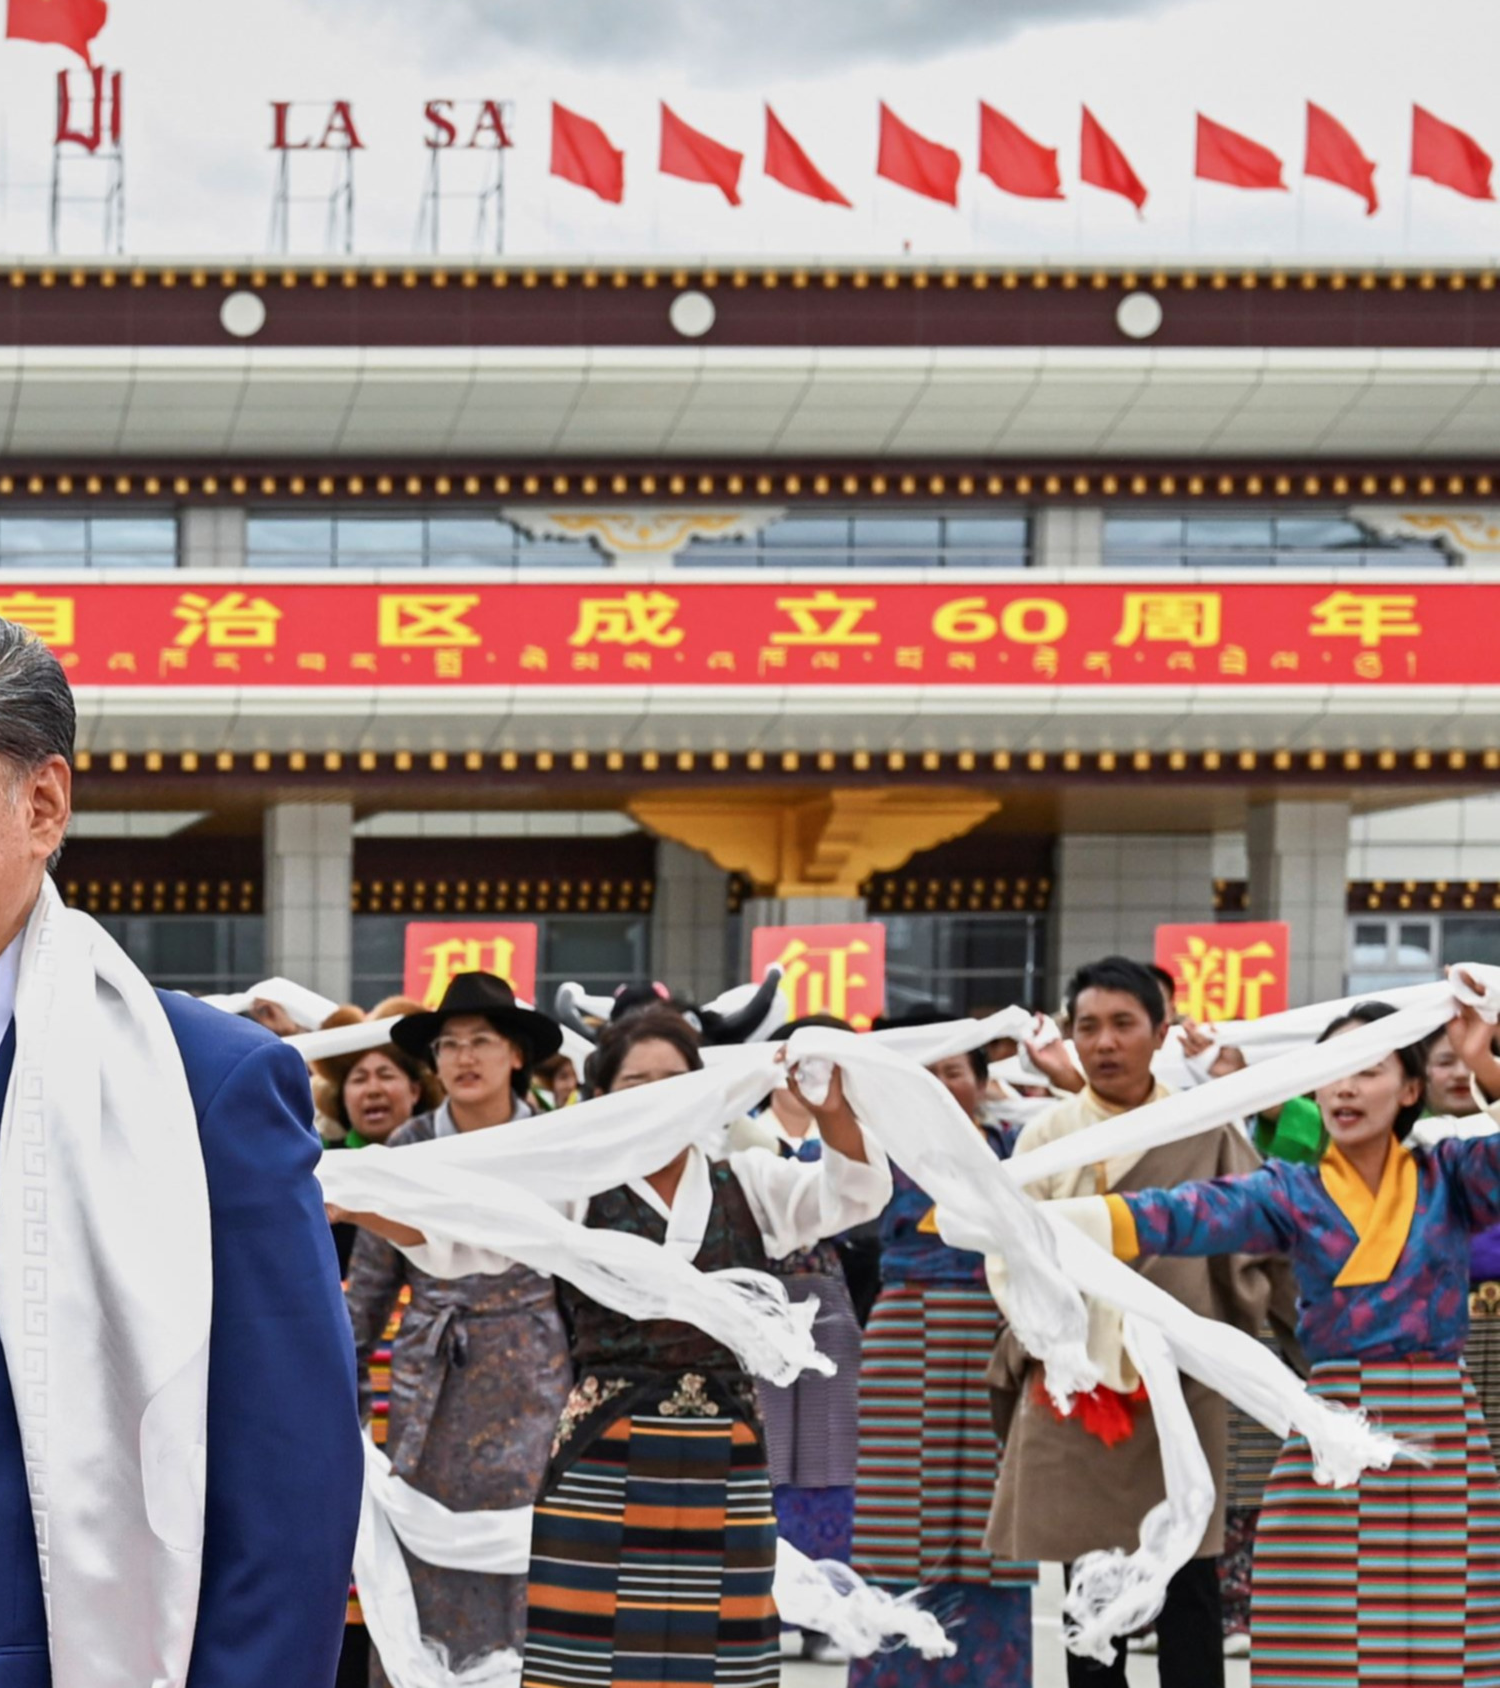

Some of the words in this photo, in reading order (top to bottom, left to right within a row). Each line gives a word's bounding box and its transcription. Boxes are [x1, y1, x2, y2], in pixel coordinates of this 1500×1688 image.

[268, 99, 367, 150] LA
[424, 99, 514, 150] SA
[777, 937, 872, 1028] 征
[1170, 935, 1276, 1025] 新
